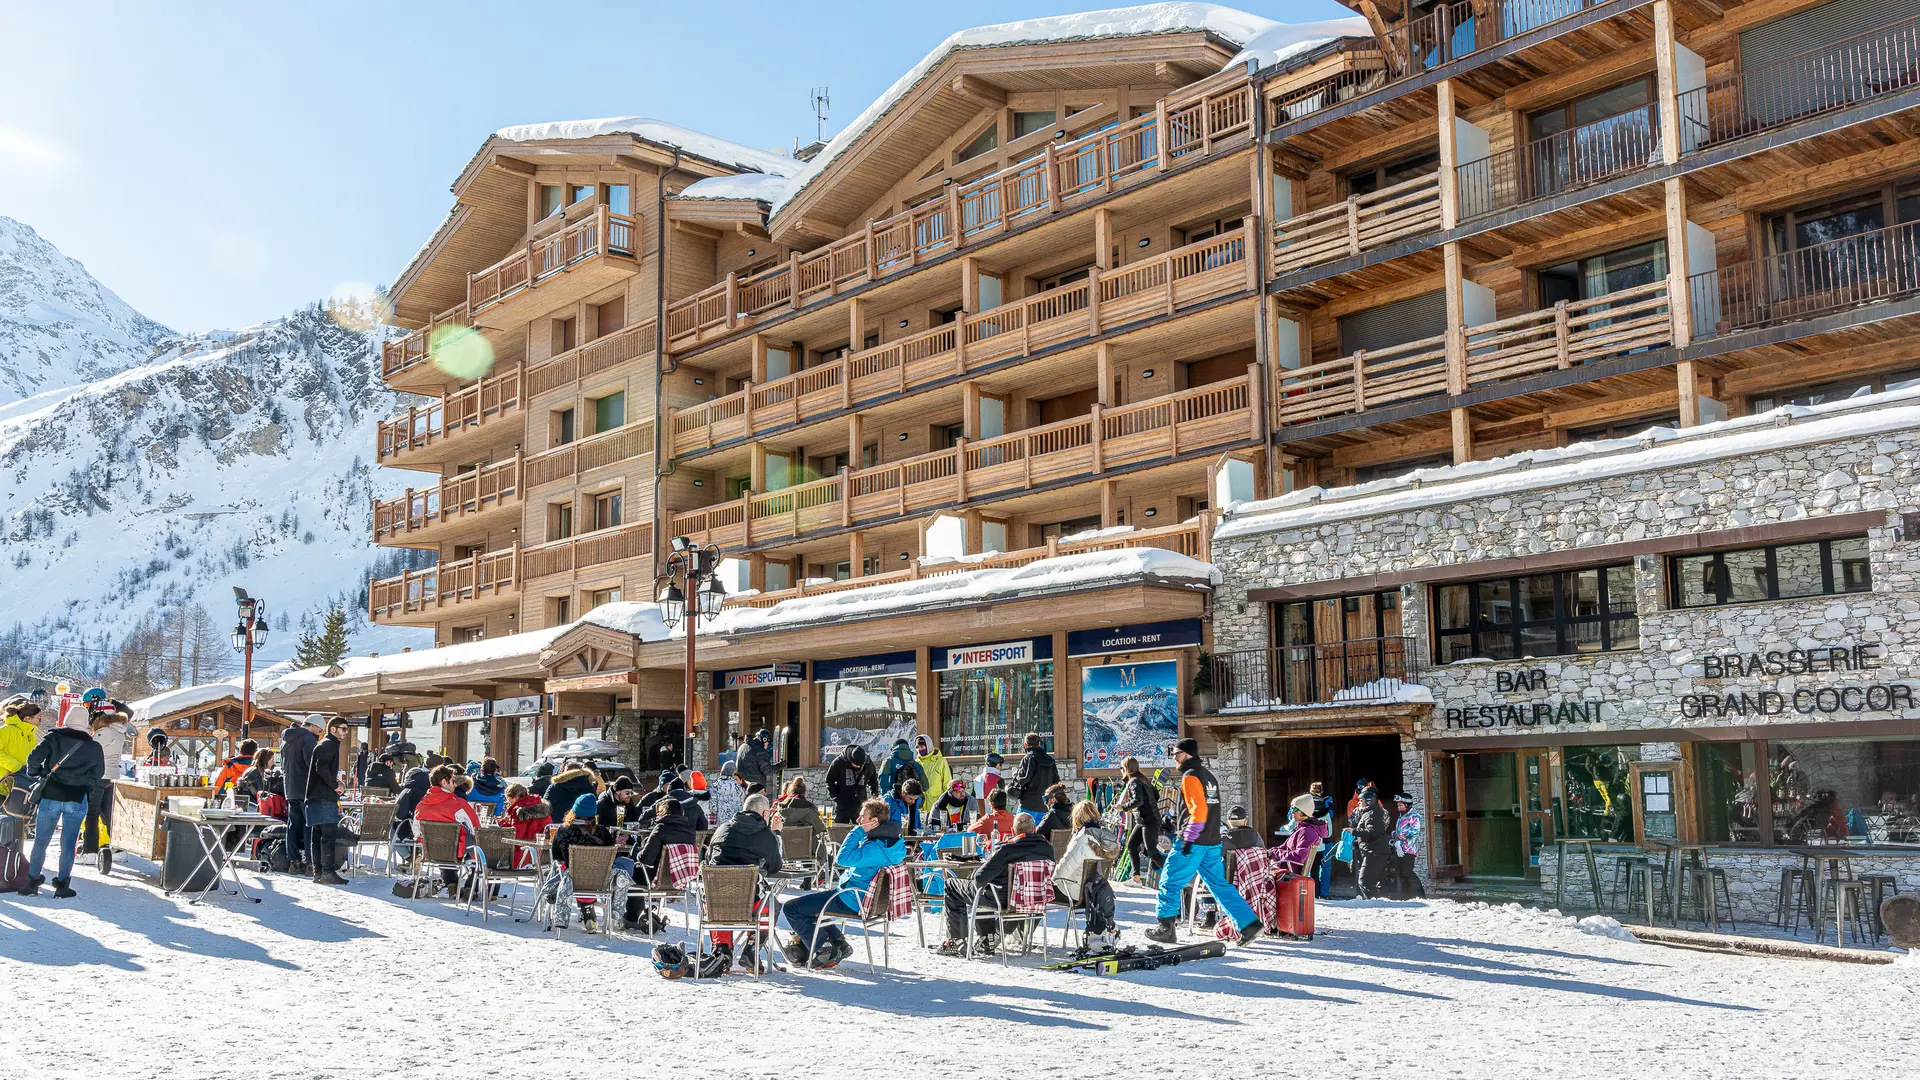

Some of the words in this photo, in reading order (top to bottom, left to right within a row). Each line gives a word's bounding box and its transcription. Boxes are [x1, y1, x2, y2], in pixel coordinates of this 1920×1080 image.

[1102, 637, 1137, 647] LOCATION
[1142, 634, 1161, 643] RENT
[962, 646, 1027, 664] INTERSPORT
[1704, 644, 1881, 679] BRASSERIE
[736, 671, 782, 685] INTERSPO
[843, 665, 868, 674] LOCATION
[1120, 668, 1137, 688] M
[1496, 669, 1547, 692] BAR
[1680, 691, 1785, 719] GRAND
[1793, 684, 1915, 714] COCOR
[452, 706, 482, 718] INTERSPORT
[1446, 701, 1606, 728] RESTAURANT
